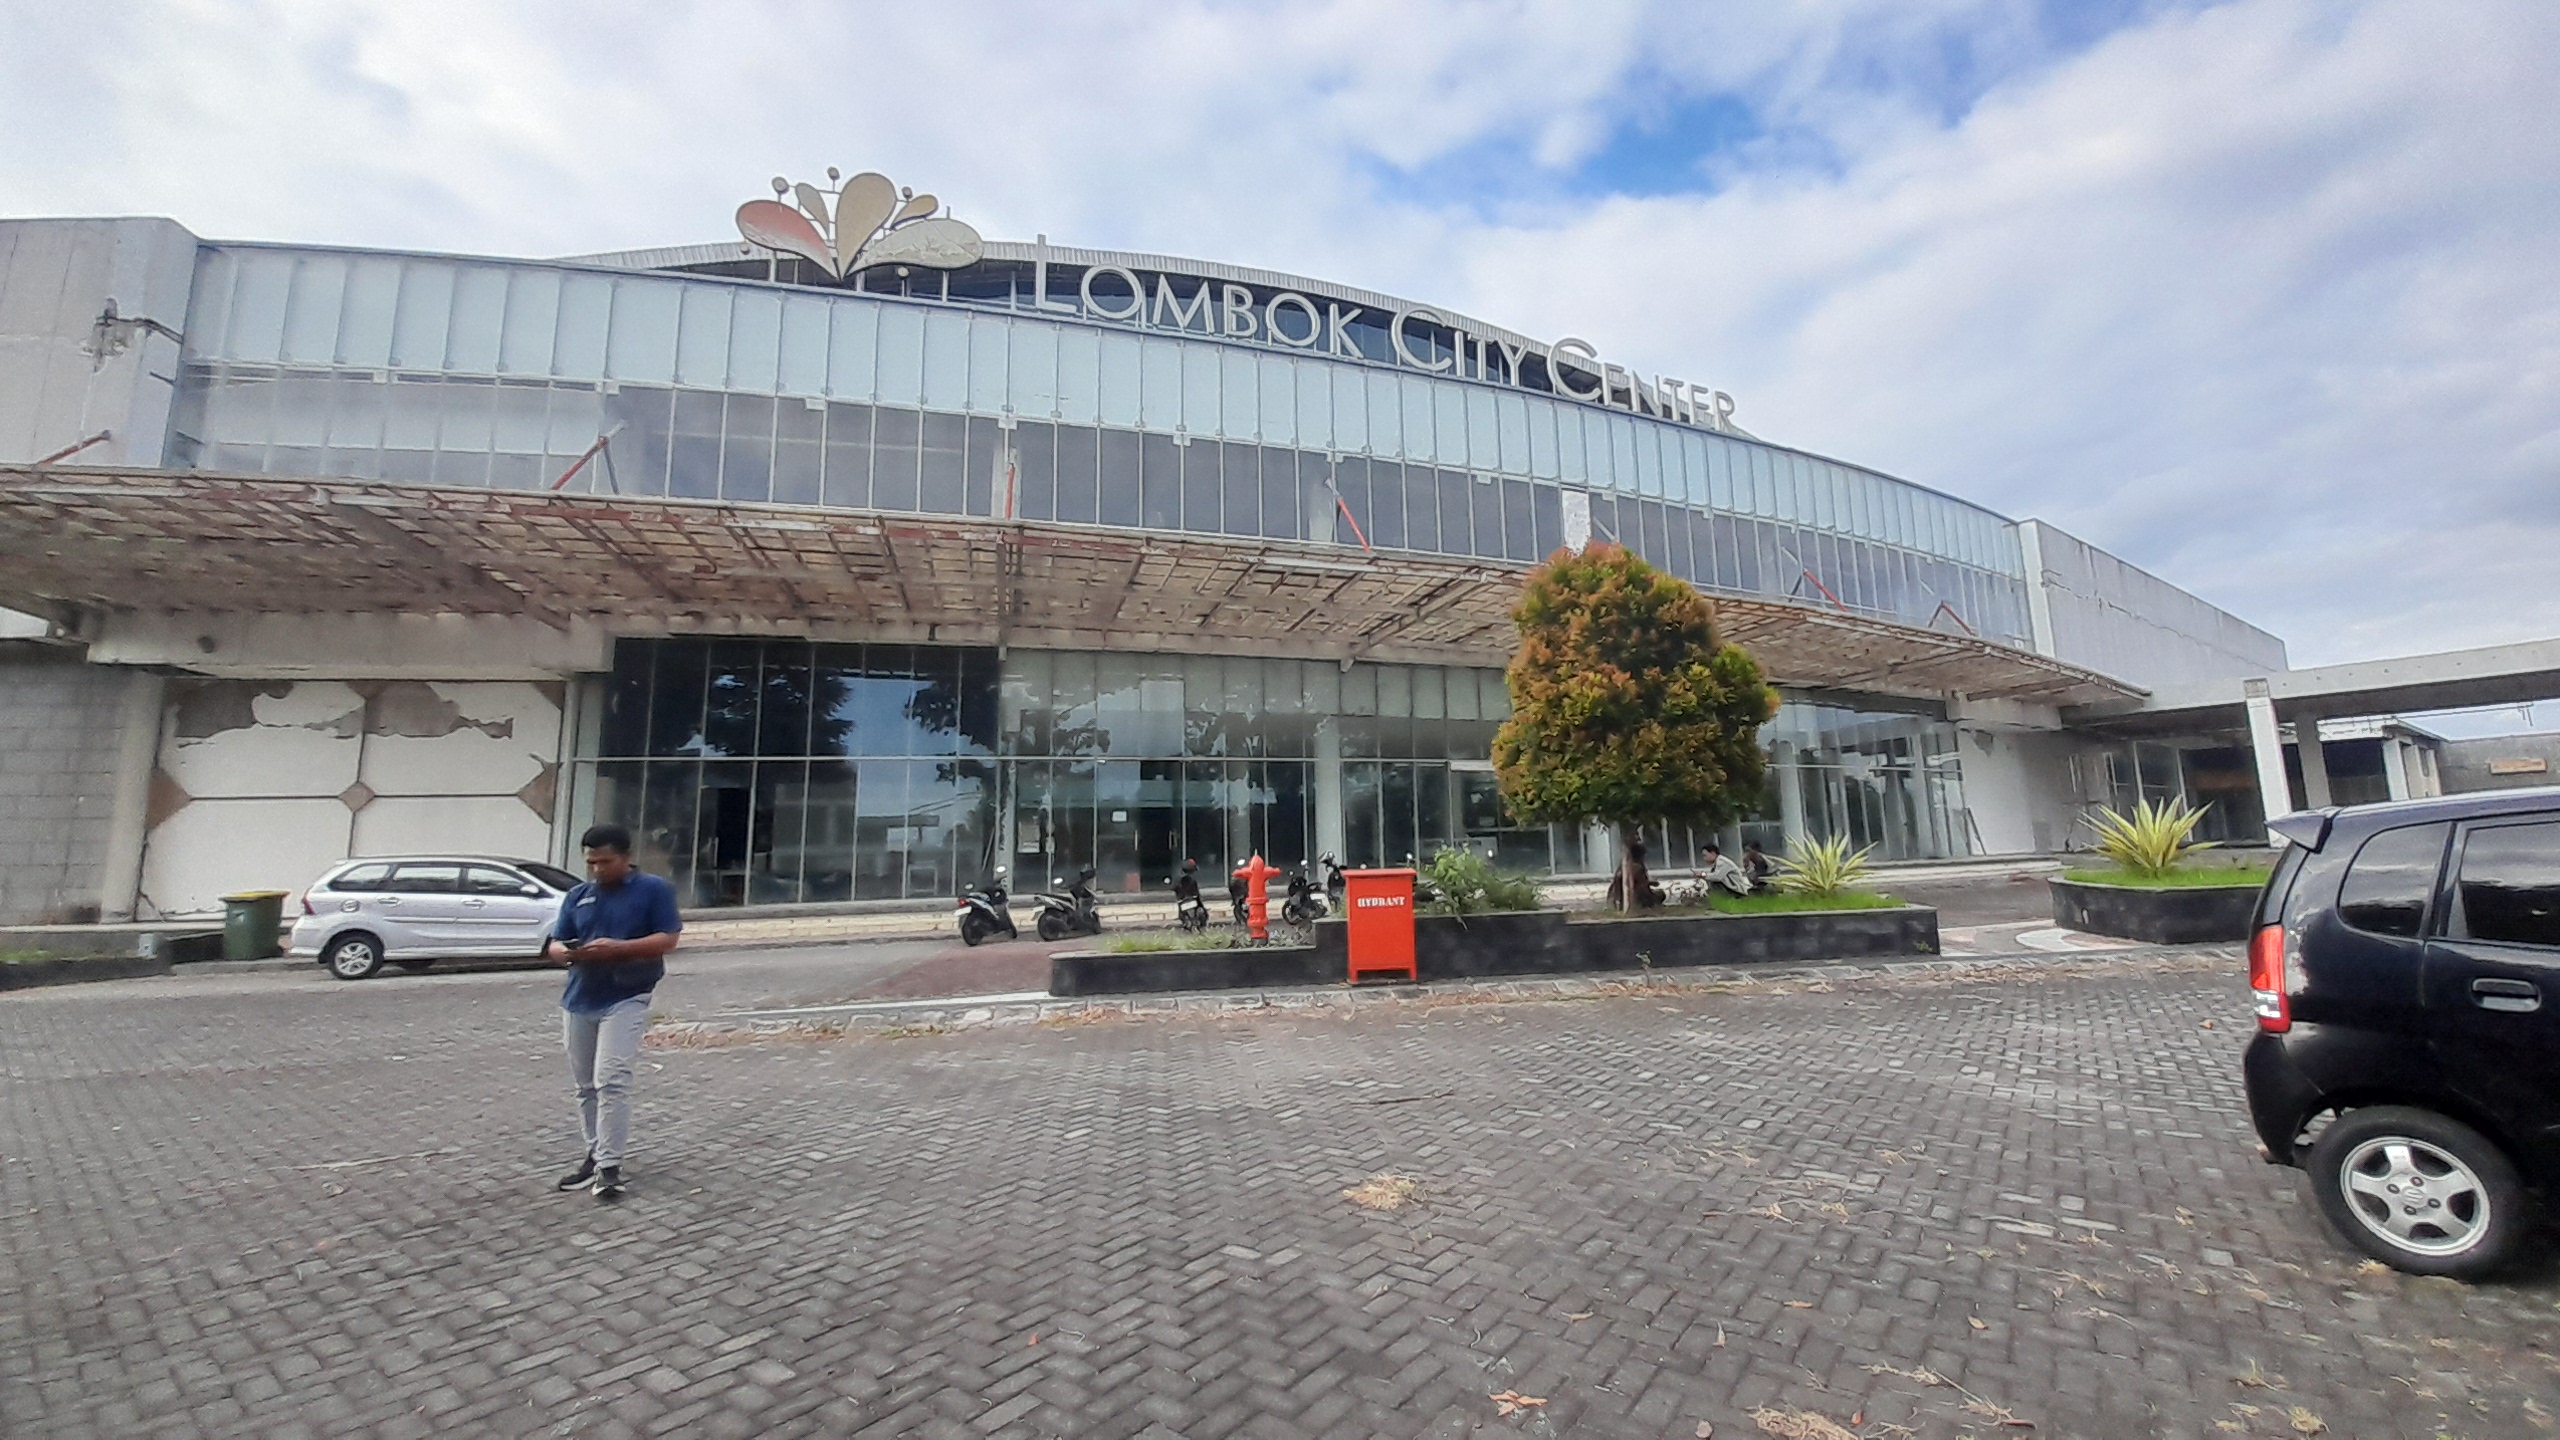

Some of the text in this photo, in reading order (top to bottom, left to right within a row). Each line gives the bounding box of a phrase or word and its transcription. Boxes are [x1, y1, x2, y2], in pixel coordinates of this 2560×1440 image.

[1034, 233, 1736, 430] LOMBOK CITY CENTER
[1357, 896, 1405, 907] HYDRANT
